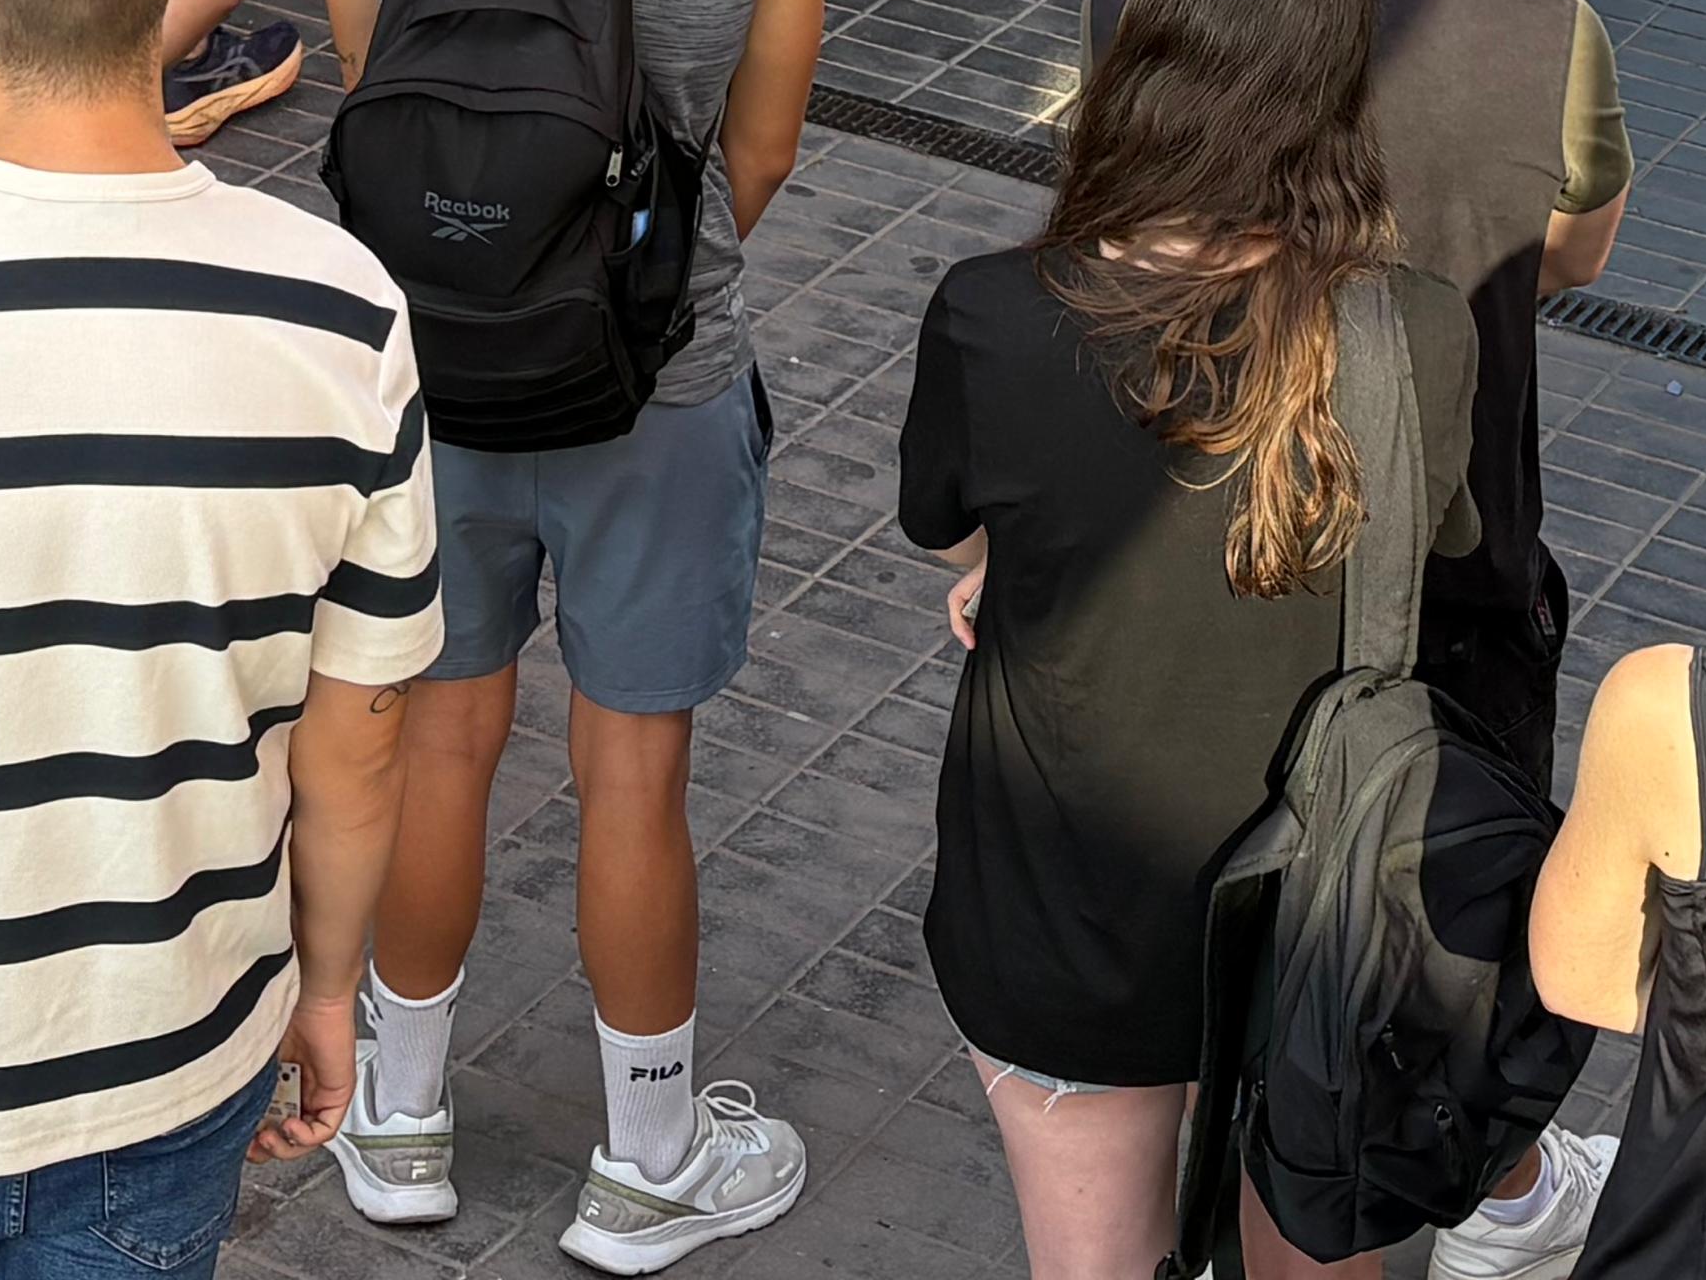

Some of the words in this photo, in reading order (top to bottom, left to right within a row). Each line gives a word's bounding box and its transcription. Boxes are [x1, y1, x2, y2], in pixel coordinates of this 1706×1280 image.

[424, 191, 511, 222] Reebok
[629, 1060, 685, 1083] FILA
[720, 1166, 747, 1197] FILA
